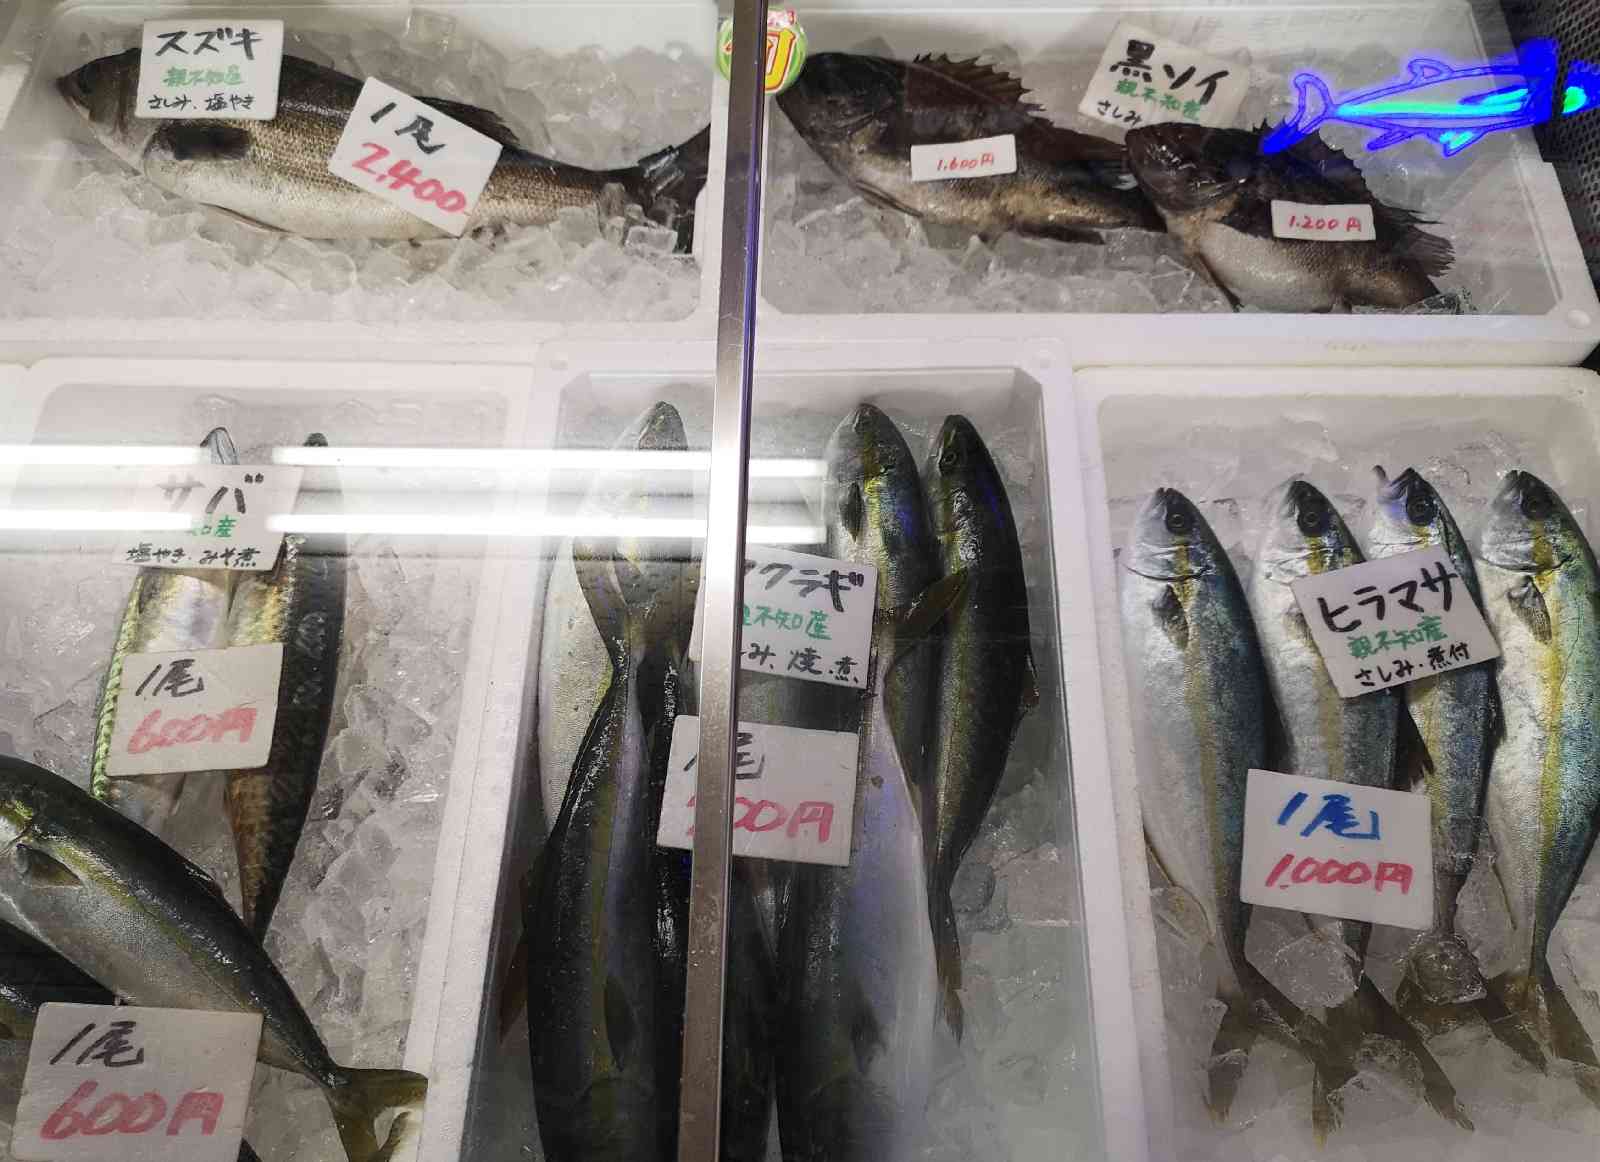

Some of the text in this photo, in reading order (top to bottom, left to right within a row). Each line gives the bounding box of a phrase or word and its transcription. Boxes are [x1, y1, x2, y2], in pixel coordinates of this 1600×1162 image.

[155, 27, 263, 60] スズキ
[1109, 39, 1229, 105] 黒ソイ
[1097, 100, 1143, 125] さしみ
[156, 472, 264, 514] サバ
[744, 559, 864, 613] クラギ
[1317, 561, 1458, 633] ヒラマサ
[1346, 615, 1447, 660] 親不知産
[136, 658, 205, 698] 1尾
[127, 708, 257, 754] 600円
[686, 796, 834, 844] 00円
[1277, 791, 1380, 840] 1尾
[49, 1020, 145, 1068] 1尾
[39, 1080, 224, 1142] 600円
